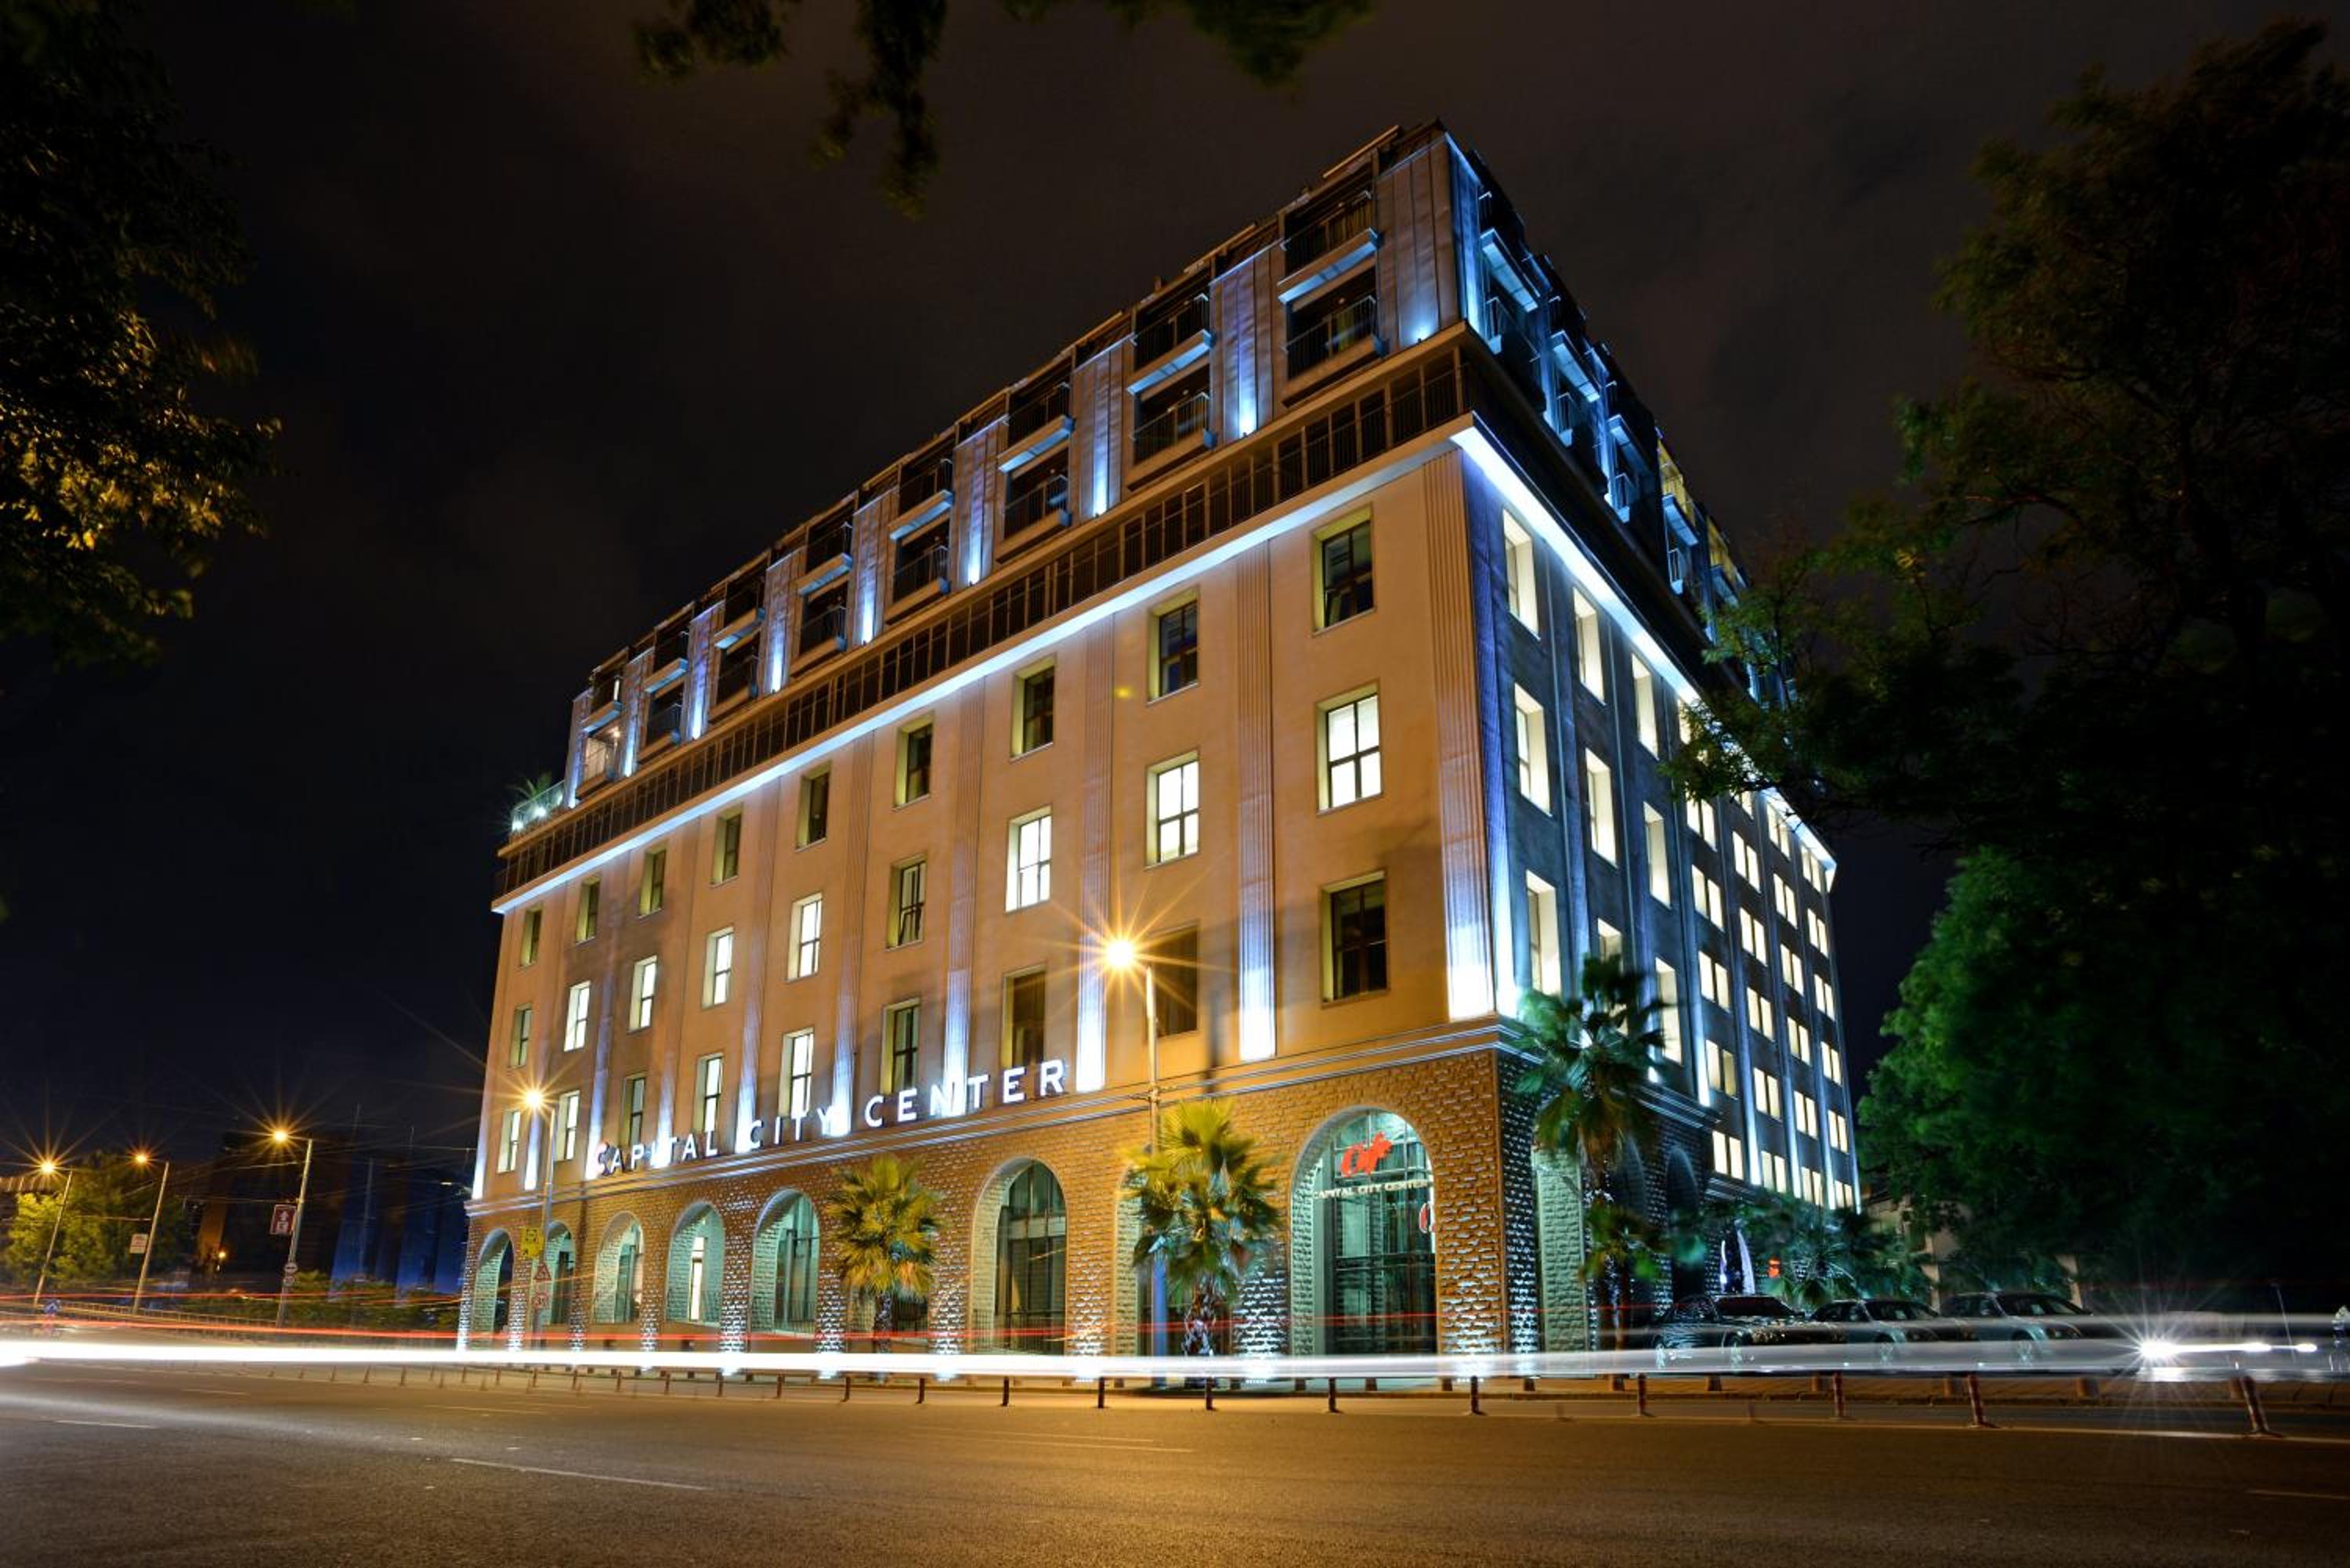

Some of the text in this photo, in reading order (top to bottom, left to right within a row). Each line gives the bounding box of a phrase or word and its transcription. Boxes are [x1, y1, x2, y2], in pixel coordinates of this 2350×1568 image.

[593, 1059, 1068, 1176] CAPITAL CITY CENTER
